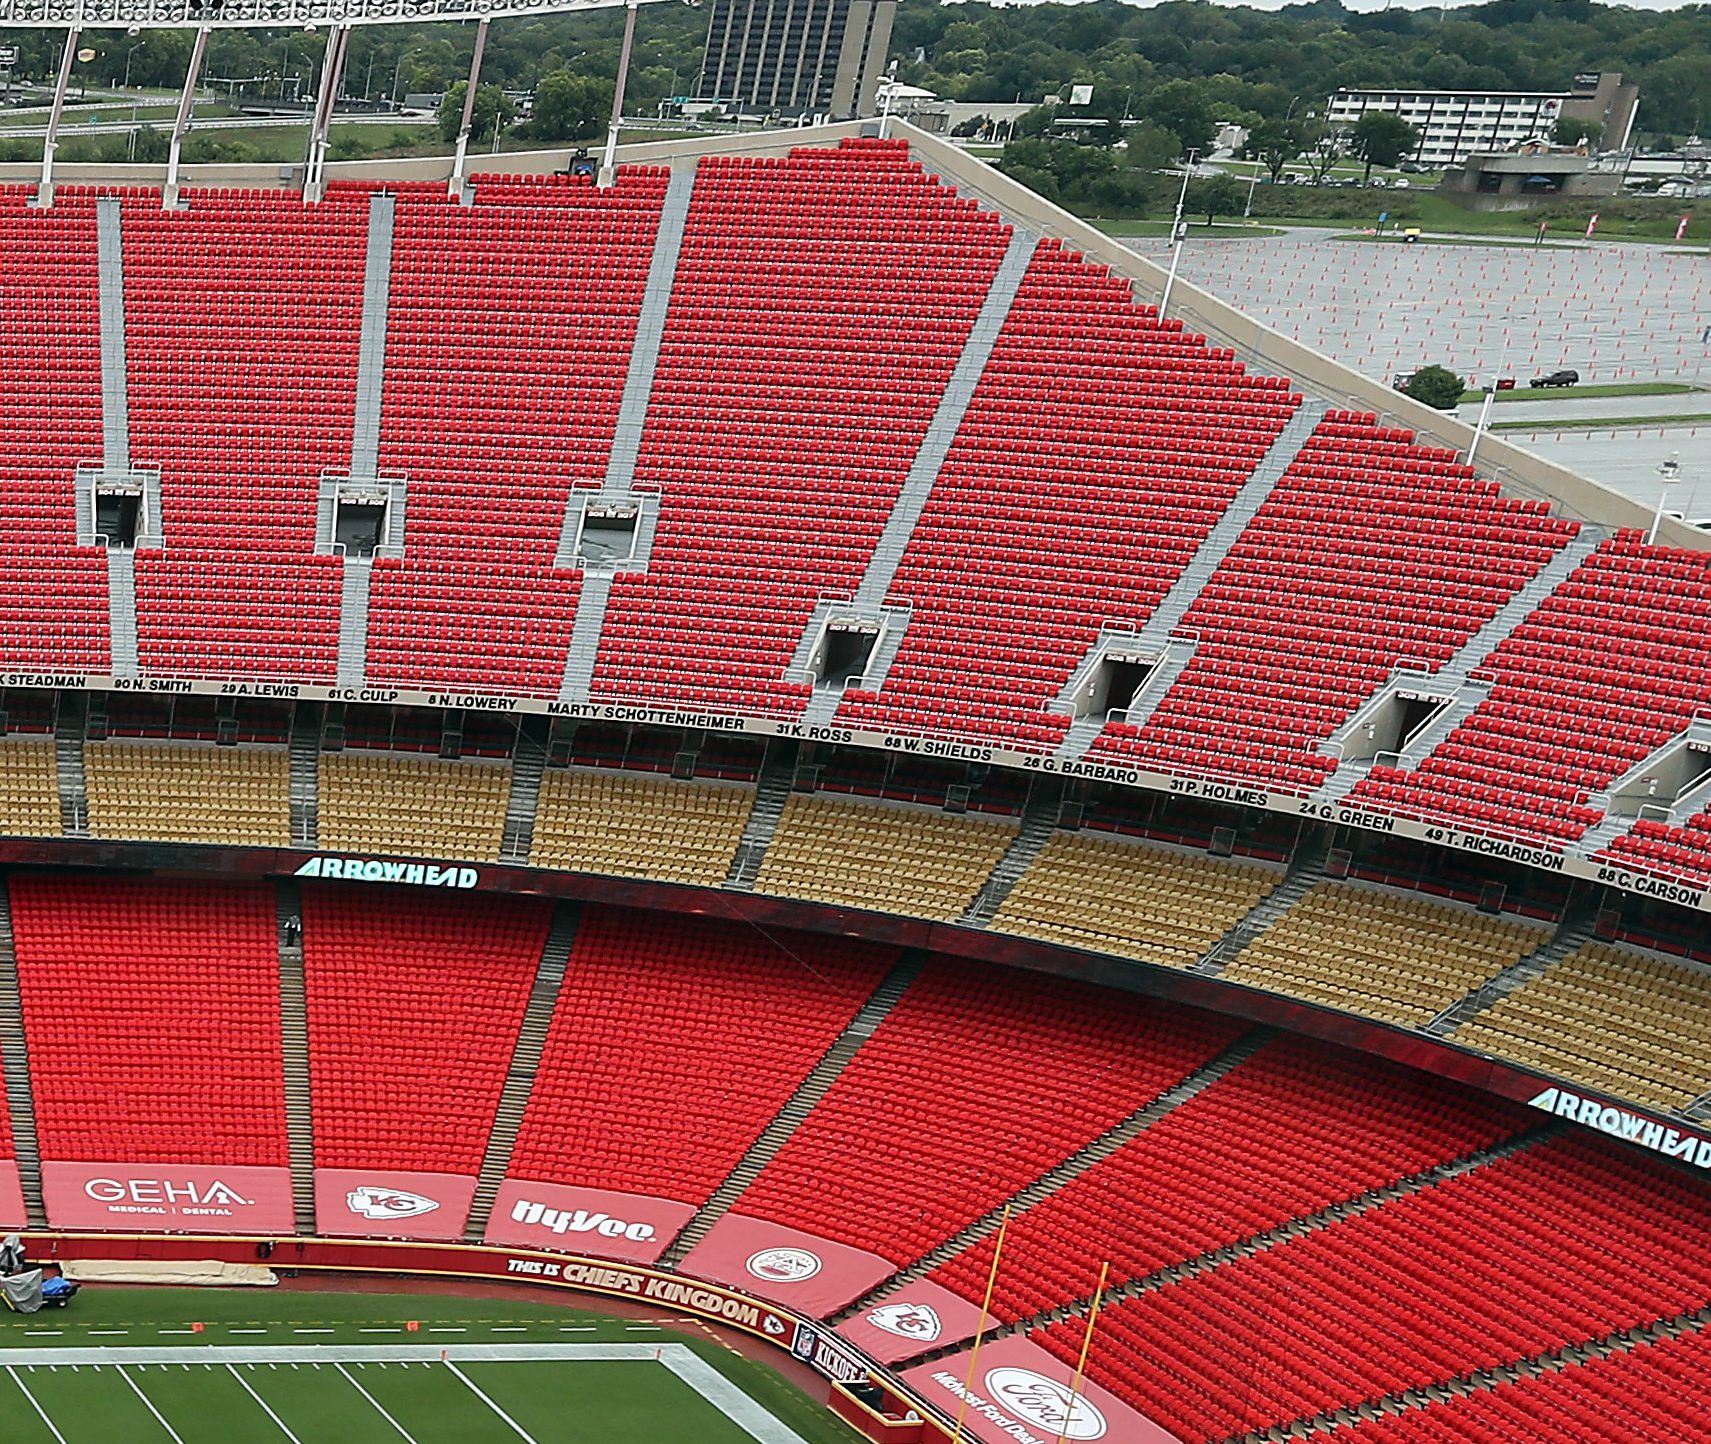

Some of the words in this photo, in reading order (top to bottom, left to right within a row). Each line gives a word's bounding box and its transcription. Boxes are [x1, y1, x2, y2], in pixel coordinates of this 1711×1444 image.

[8, 675, 85, 687] STEADMAN
[114, 679, 130, 688] 90
[133, 679, 145, 689] N.
[149, 680, 192, 692] SMITH
[221, 684, 236, 693] 29
[238, 684, 252, 694] A.
[255, 685, 298, 697] LEWIS
[547, 703, 600, 716] MARTY
[604, 707, 744, 730] SCHOTTENHEIMER
[885, 737, 901, 748] 68
[904, 739, 919, 751] W.
[924, 742, 992, 761] SHIELDS
[1023, 757, 1040, 767] 26
[1043, 759, 1058, 771] G.
[1062, 761, 1138, 783] BARBARO
[1299, 803, 1316, 814] 24
[1320, 806, 1335, 819] G.
[1339, 810, 1394, 831] GREEN
[1425, 828, 1443, 840] 49
[1447, 831, 1458, 845] T.
[1463, 835, 1564, 870] RICHARDSON
[293, 857, 478, 888] ARROWHEAD
[1598, 868, 1616, 881] 88
[1618, 873, 1631, 888] C.
[1635, 878, 1701, 907] CARSON
[1527, 1087, 1711, 1169] ARROWHEAD
[507, 1258, 542, 1275] THIS
[543, 1263, 560, 1277] IS
[562, 1263, 645, 1293] CHIEFS
[644, 1281, 760, 1327] KINGDOM
[930, 1370, 986, 1412] Midwest
[977, 1402, 1012, 1434] Ford
